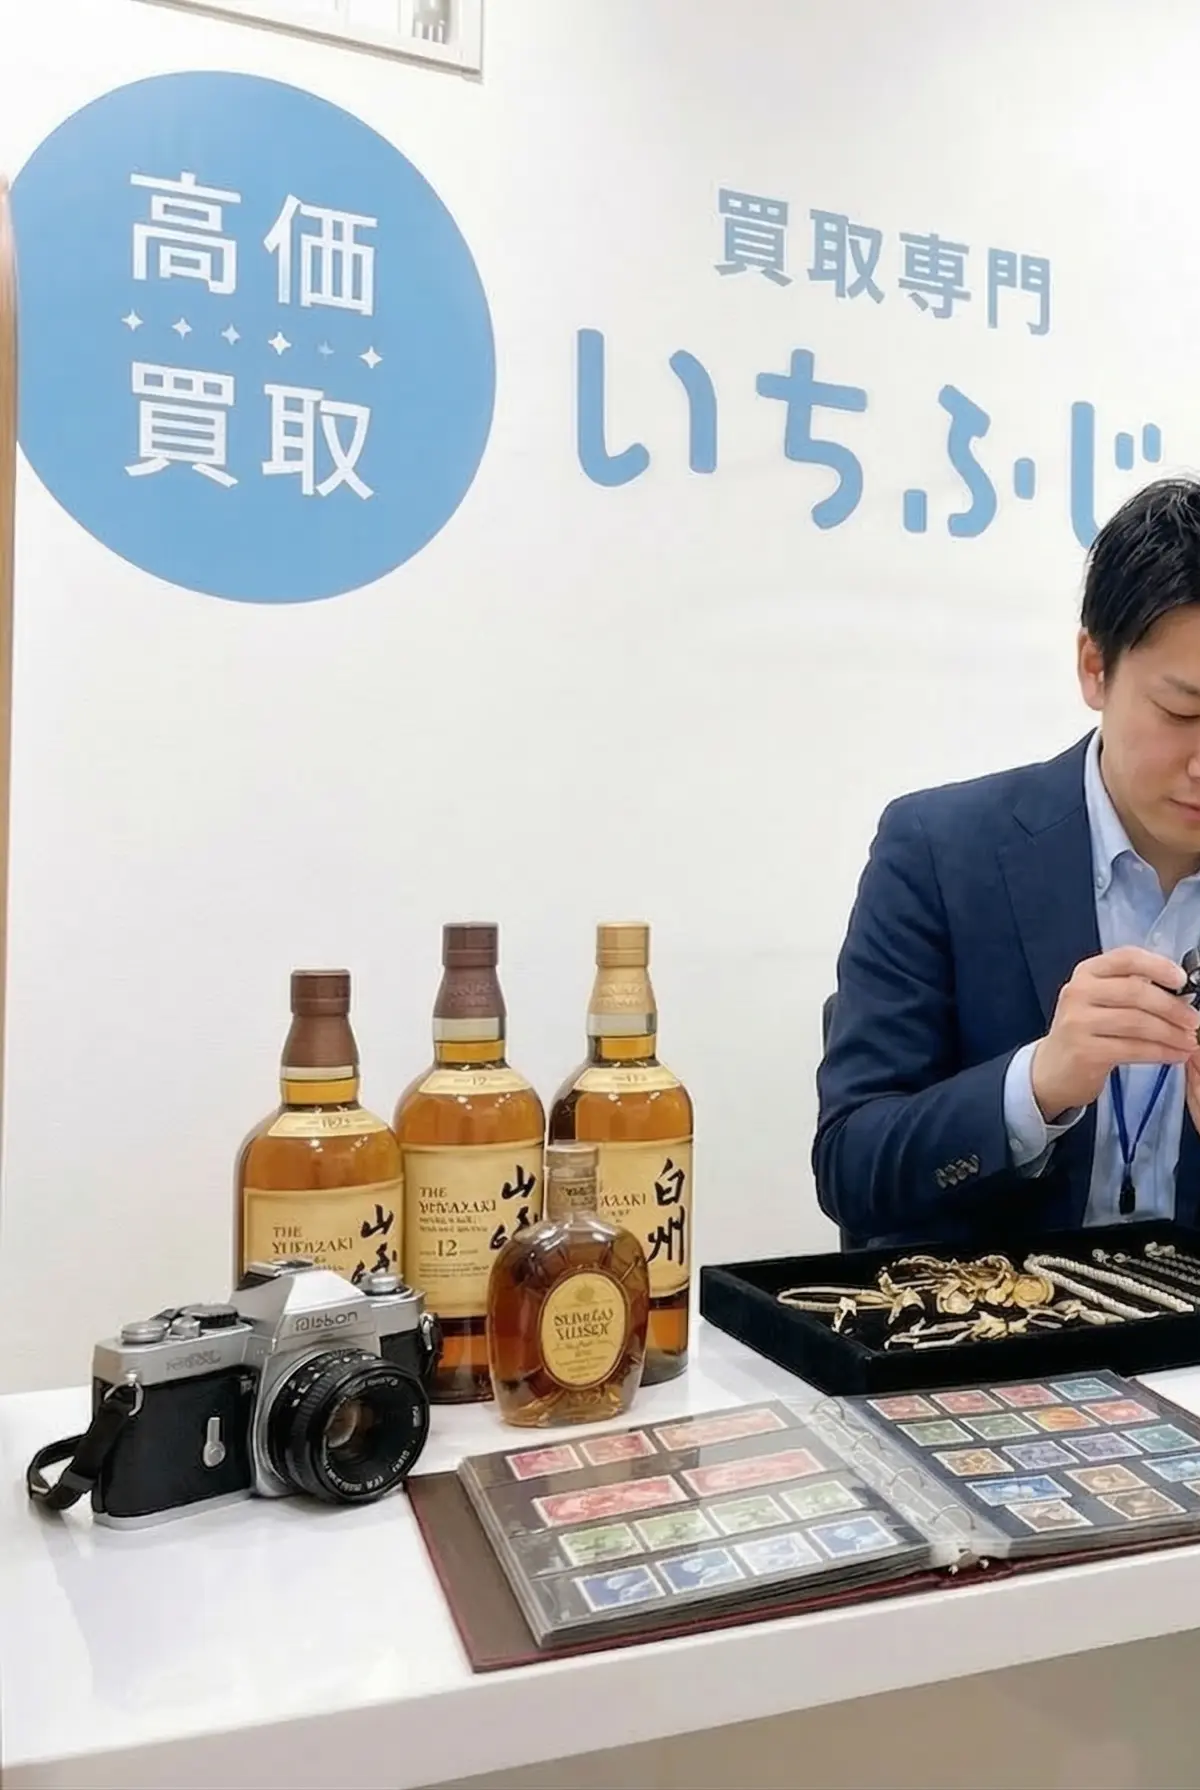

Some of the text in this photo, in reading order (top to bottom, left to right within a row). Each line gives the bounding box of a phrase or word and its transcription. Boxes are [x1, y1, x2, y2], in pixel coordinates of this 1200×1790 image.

[129, 170, 378, 316] 高価
[714, 187, 1051, 335] 買取専門
[124, 361, 375, 500] 買取
[577, 328, 1161, 550] いちふじ
[272, 1226, 302, 1239] THE
[420, 1187, 448, 1199] THE
[437, 1239, 458, 1257] 12
[646, 1157, 686, 1266] 白州
